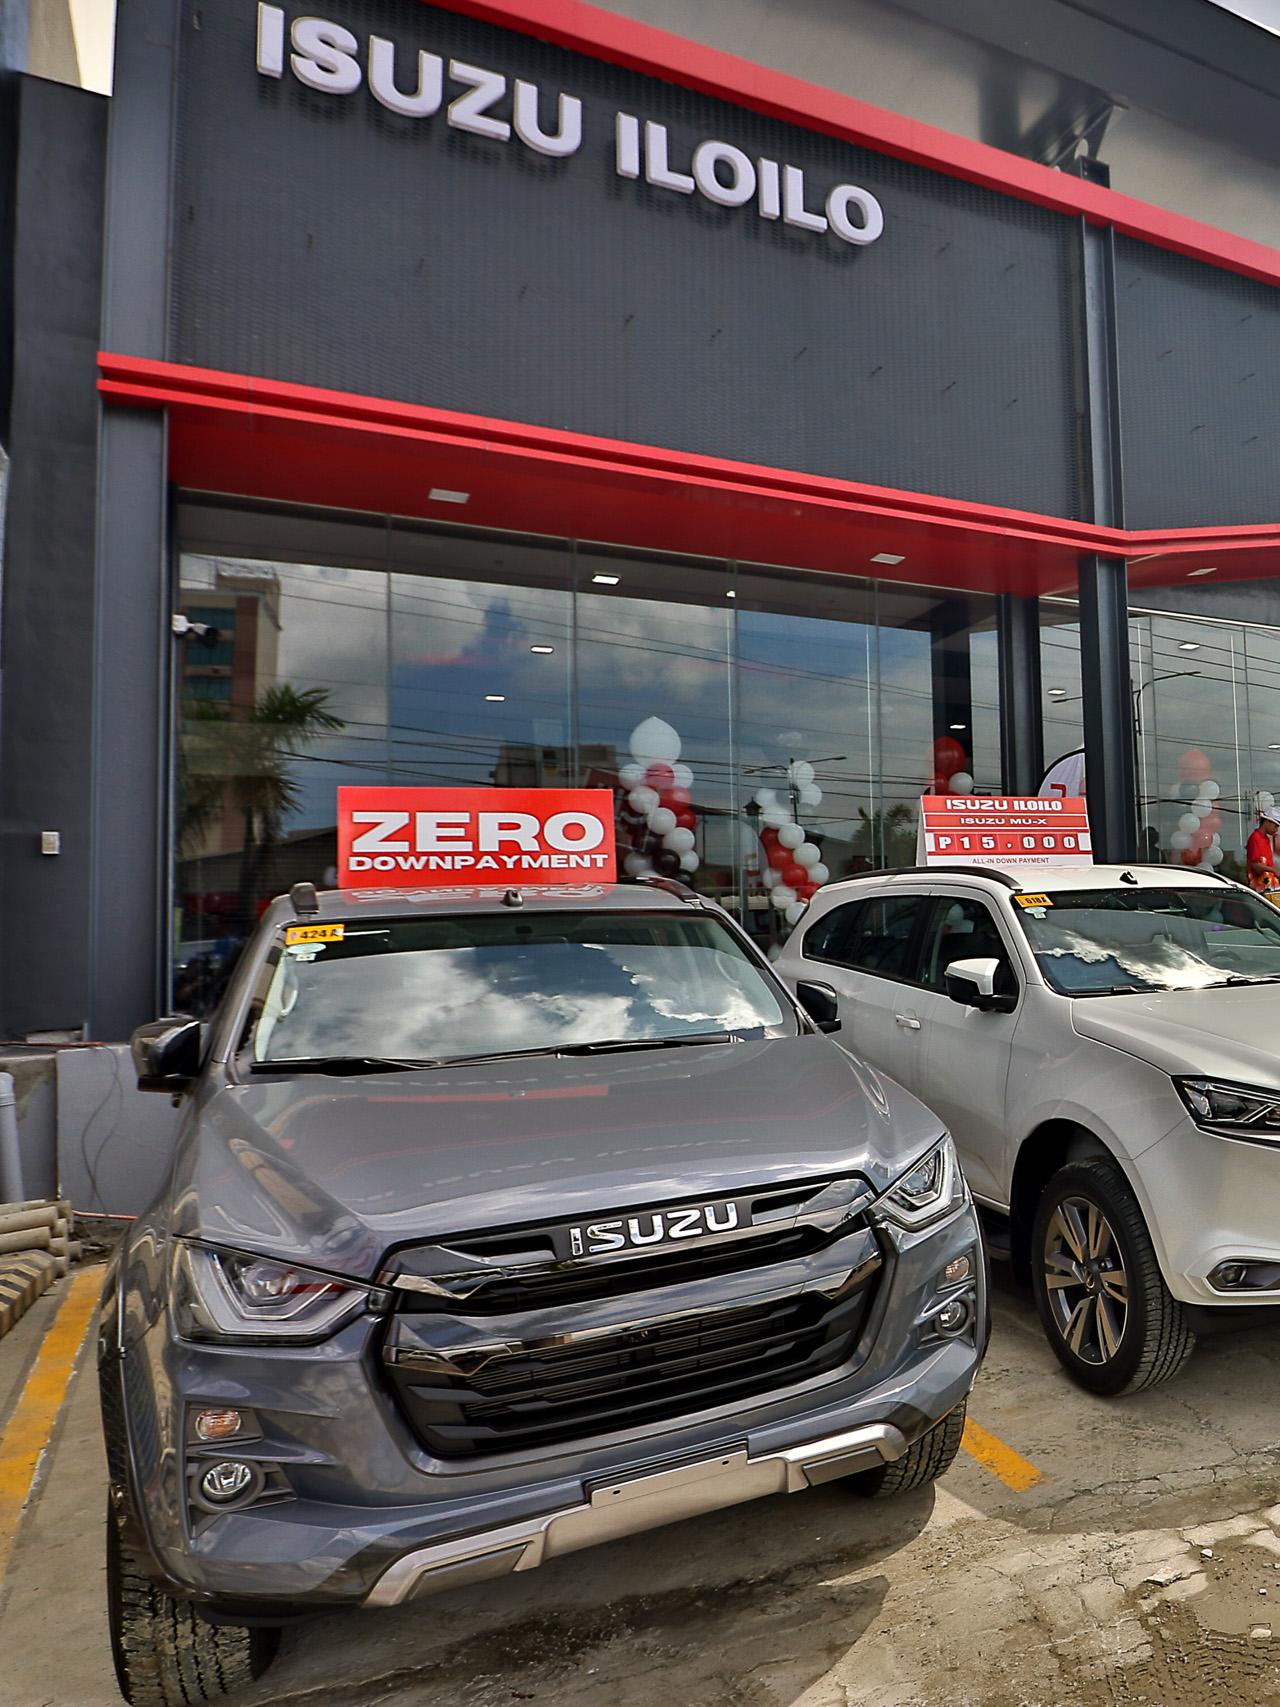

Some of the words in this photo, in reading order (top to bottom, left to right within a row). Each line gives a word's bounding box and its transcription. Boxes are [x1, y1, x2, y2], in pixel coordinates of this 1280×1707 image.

[256, 1, 582, 158] ISUZU
[615, 111, 884, 245] ILOILO
[946, 799, 1008, 811] ISUZU
[1013, 800, 1063, 811] ILOILO
[352, 811, 605, 853] ZERO
[960, 817, 1005, 825] ISUZU
[348, 854, 609, 872] DOWNPAYMENT
[569, 1202, 738, 1257] ISUZU
